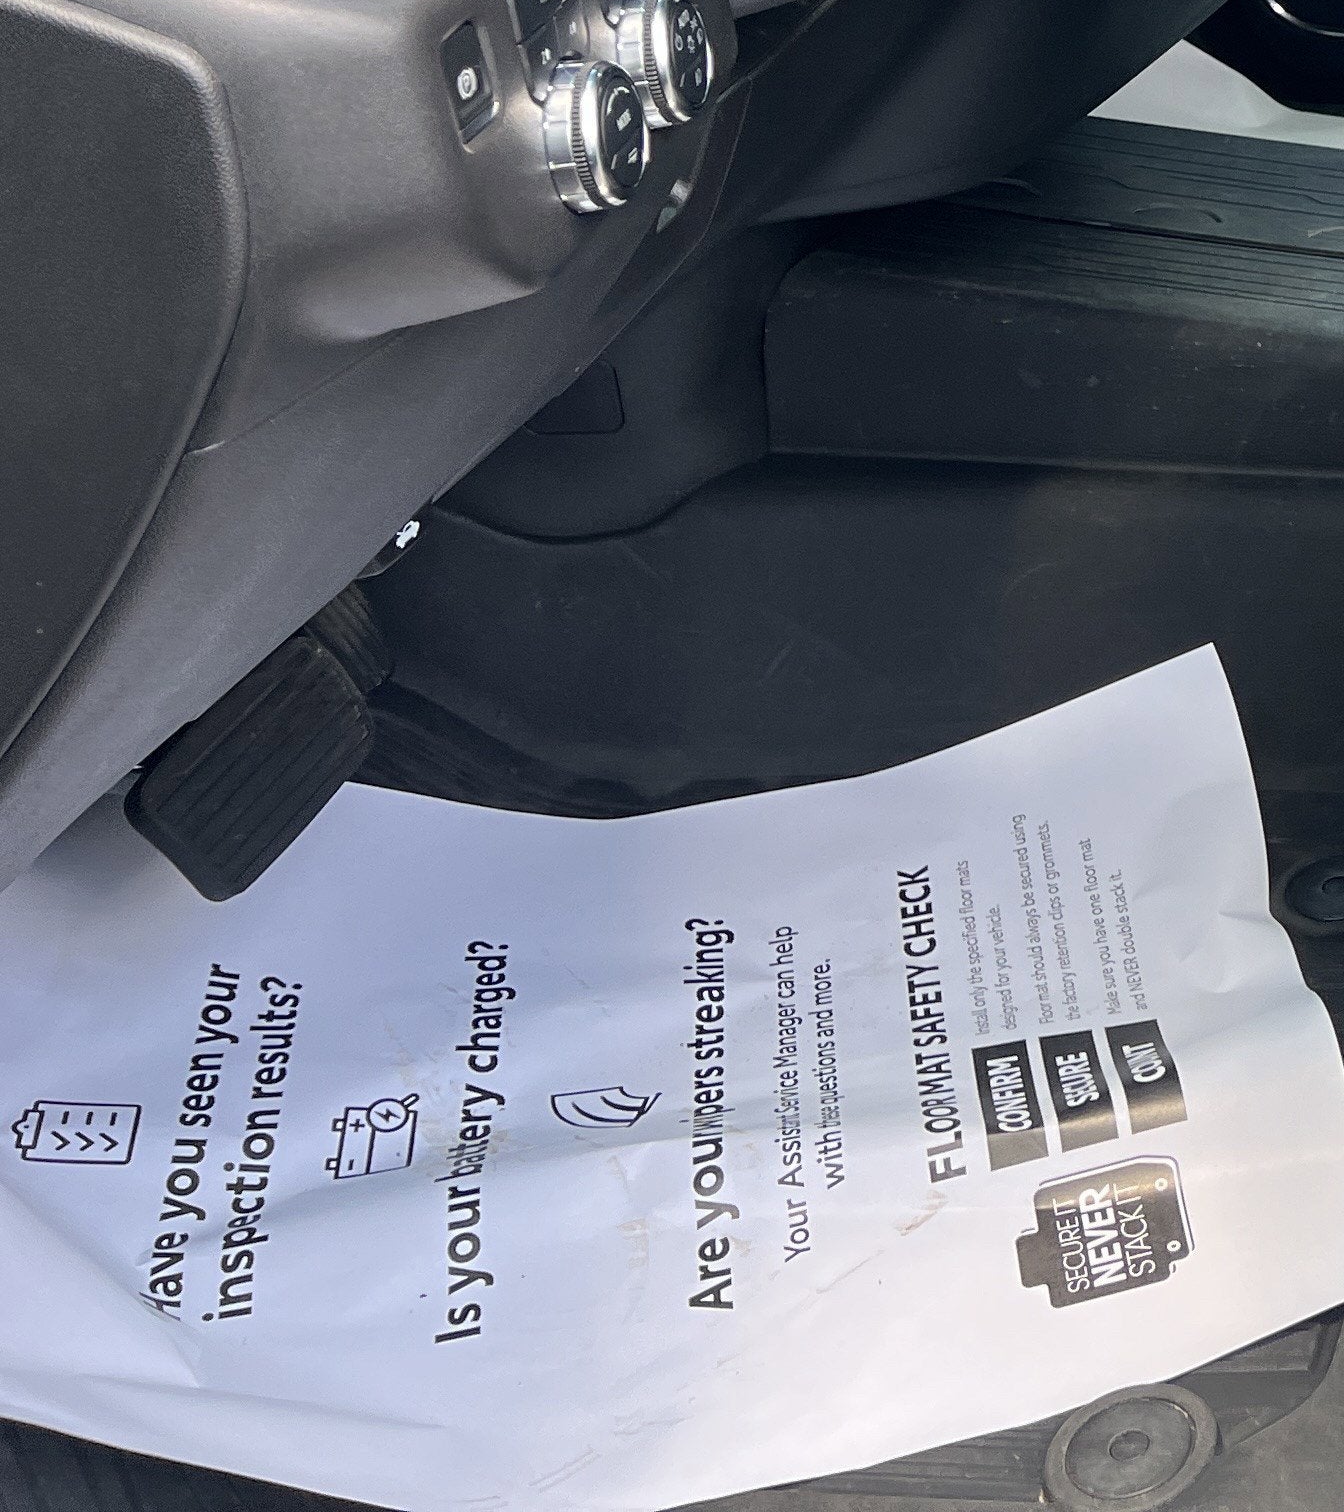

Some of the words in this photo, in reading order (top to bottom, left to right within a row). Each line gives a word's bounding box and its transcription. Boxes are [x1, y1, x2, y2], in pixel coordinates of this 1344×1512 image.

[1011, 814, 1027, 844] using
[1038, 820, 1060, 878] grommets.
[1014, 848, 1033, 890] secured
[1078, 839, 1092, 862] mat
[956, 860, 970, 886] mats
[1045, 882, 1058, 894] or
[1084, 864, 1100, 892] floor
[1110, 870, 1122, 882] it.
[897, 865, 936, 957] CHECK
[959, 889, 974, 914] floor
[1018, 892, 1034, 906] be
[1045, 896, 1062, 920] clips
[1089, 894, 1103, 915] one
[1111, 883, 1126, 914] stack
[960, 916, 983, 965] specified
[988, 904, 1004, 944] vehicle.
[1022, 908, 1041, 944] always
[1090, 918, 1108, 944] have
[1116, 916, 1136, 954] double
[768, 926, 797, 966] help
[996, 947, 1012, 970] your
[1025, 946, 1046, 981] should
[1050, 923, 1070, 969] retention
[1096, 946, 1116, 966] you
[680, 917, 735, 1060] streaking?
[776, 970, 795, 999] can
[813, 957, 833, 1006] more.
[966, 967, 983, 984] the
[994, 973, 1009, 987] for
[1036, 983, 1050, 1001] mat
[1059, 972, 1078, 1005] factory
[1098, 968, 1114, 988] sure
[1125, 958, 1144, 991] NEVER
[193, 963, 242, 1045] your
[454, 940, 515, 1074] charged?
[906, 964, 948, 1046] SAFETY
[968, 986, 988, 1007] only
[994, 989, 1018, 1030] designed
[1037, 1001, 1054, 1024] Floor
[1064, 1006, 1080, 1020] the
[1102, 991, 1122, 1014] Make
[1133, 994, 1148, 1010] and
[770, 1002, 802, 1068] Manager
[810, 1009, 834, 1038] and
[972, 1008, 990, 1036] Install
[811, 1041, 845, 1105] questions
[914, 1050, 953, 1096] MAT
[1055, 1052, 1101, 1107] SECURE
[1122, 1041, 1167, 1083] COUNT
[175, 1052, 225, 1128] seen
[679, 1066, 736, 1130] wipers
[773, 1070, 800, 1113] Service
[986, 1055, 1033, 1132] CONFIRM
[435, 1084, 506, 1183] battery
[815, 1104, 840, 1129] these
[203, 1108, 280, 1322] inspection
[248, 975, 302, 1100] results?
[773, 1113, 805, 1189] Assistant
[817, 1130, 845, 1189] with
[922, 1096, 966, 1183] FLOOR
[158, 1138, 210, 1222] you
[686, 1128, 739, 1229] your
[1114, 1183, 1142, 1204] IT
[1053, 1198, 1075, 1217] IT
[438, 1185, 494, 1294] your
[782, 1200, 812, 1262] Your
[1080, 1183, 1127, 1287] NEVER
[1119, 1205, 1156, 1276] STACK
[687, 1236, 734, 1311] Are
[1057, 1217, 1090, 1293] SECURE
[139, 1231, 190, 1321] Have
[435, 1303, 482, 1345] Is
